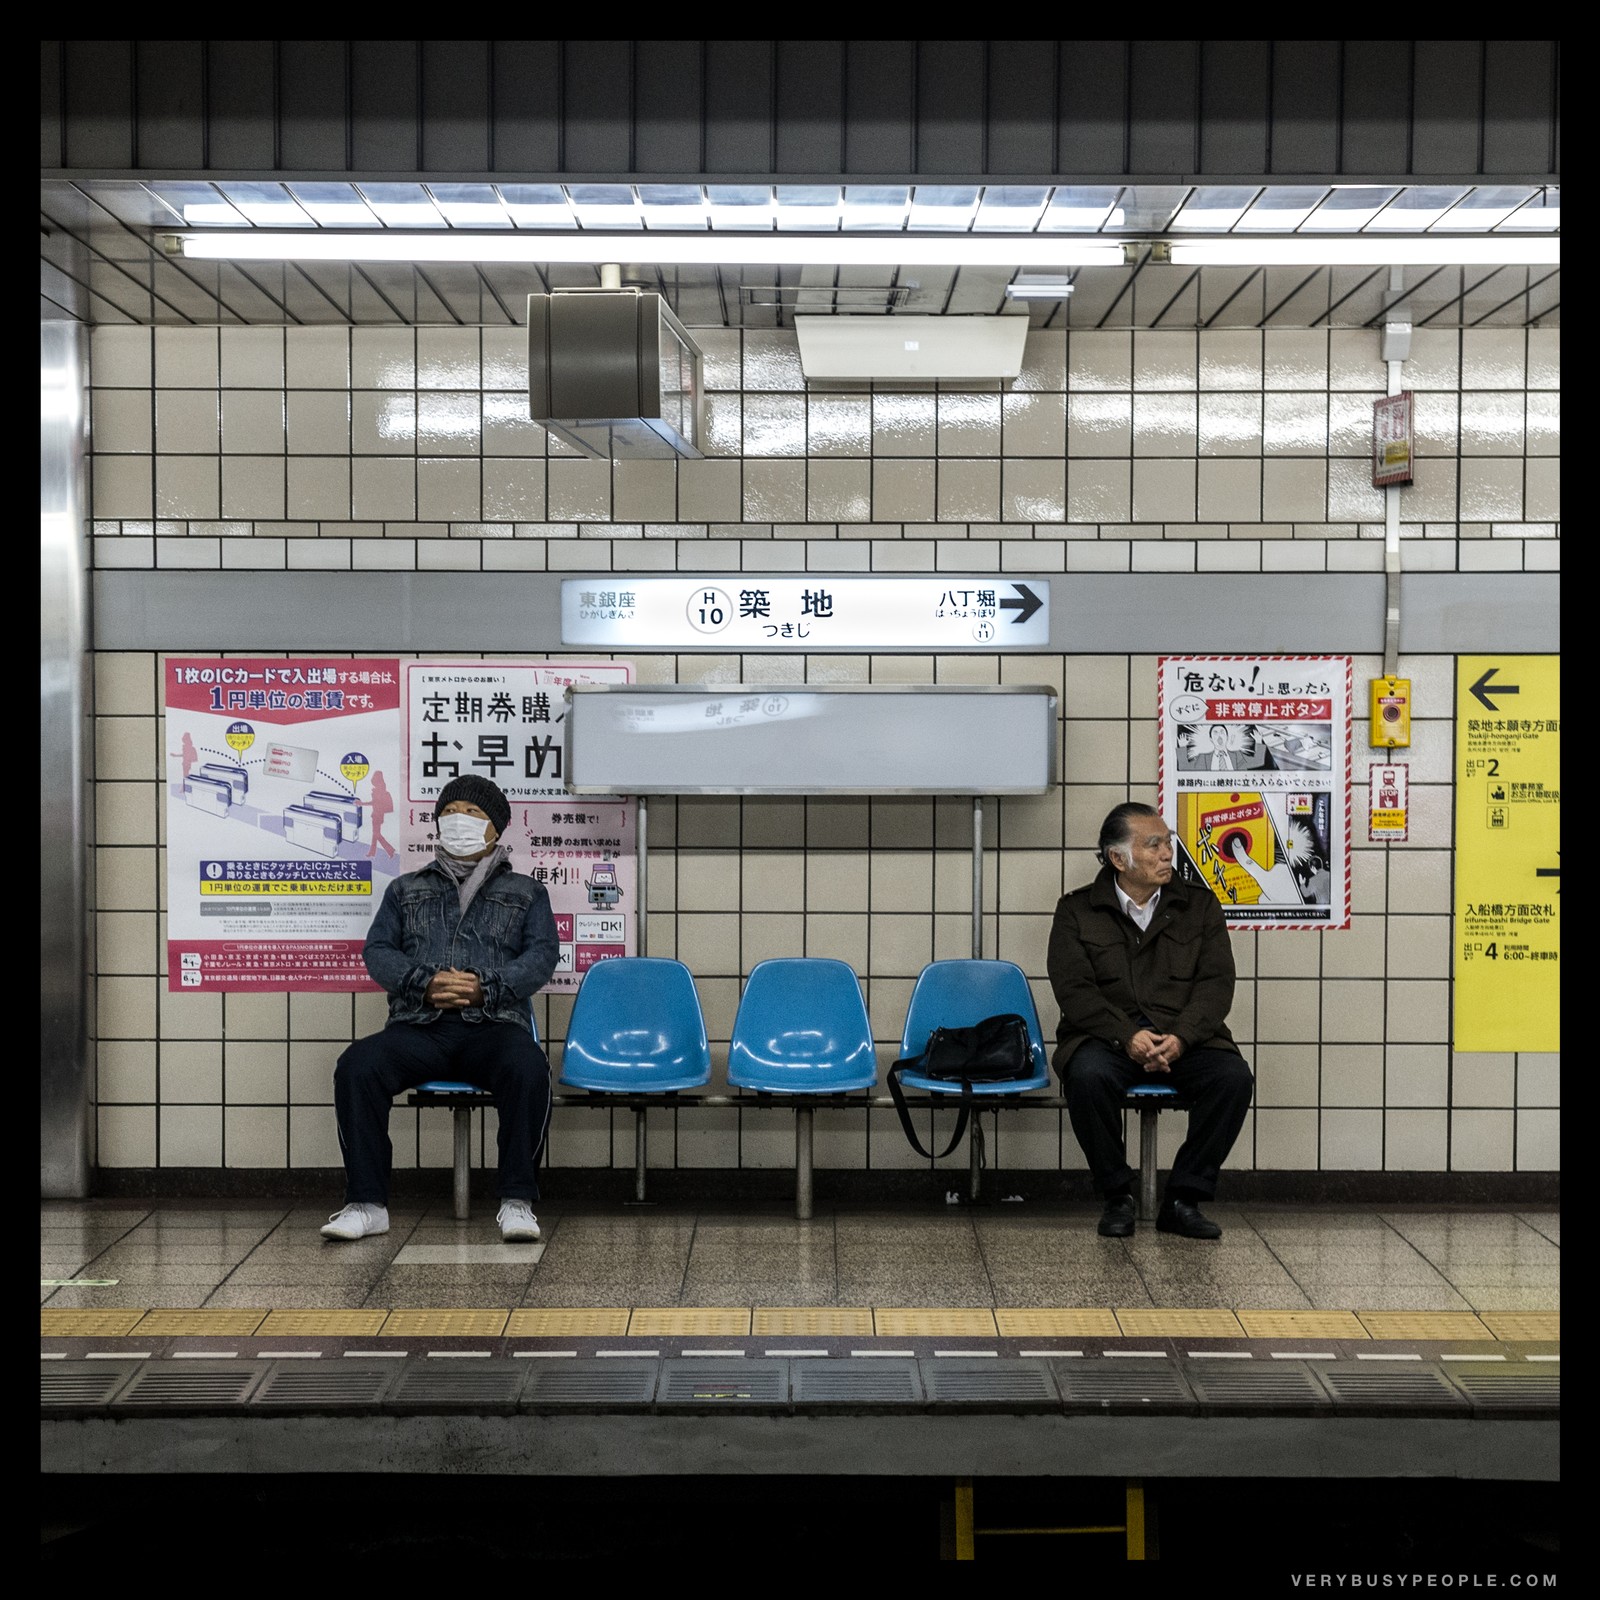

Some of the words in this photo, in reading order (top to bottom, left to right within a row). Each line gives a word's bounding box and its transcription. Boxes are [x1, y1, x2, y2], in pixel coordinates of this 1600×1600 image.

[579, 591, 636, 608] 東銀座
[704, 592, 715, 604] H
[739, 588, 834, 618] 築地
[939, 589, 996, 607] 八丁堀
[699, 608, 723, 625] 10
[762, 622, 810, 638] つきじ
[978, 630, 989, 638] 11
[175, 667, 397, 685] 1枚のICカードで入出場する場合は、
[209, 686, 374, 710] 1円単位の運賃です。
[1215, 703, 1326, 718] 非常停止ボタン
[1467, 719, 1560, 732] 築地本願寺方面
[1466, 759, 1485, 768] 出口
[1487, 758, 1500, 777] 2
[551, 812, 600, 824] 券売機で!
[1465, 903, 1556, 917] 入船橋方面改札
[601, 921, 622, 931] OK!
[1509, 917, 1532, 925] Bridge
[1463, 942, 1483, 952] 出口
[1485, 942, 1498, 960] 4
